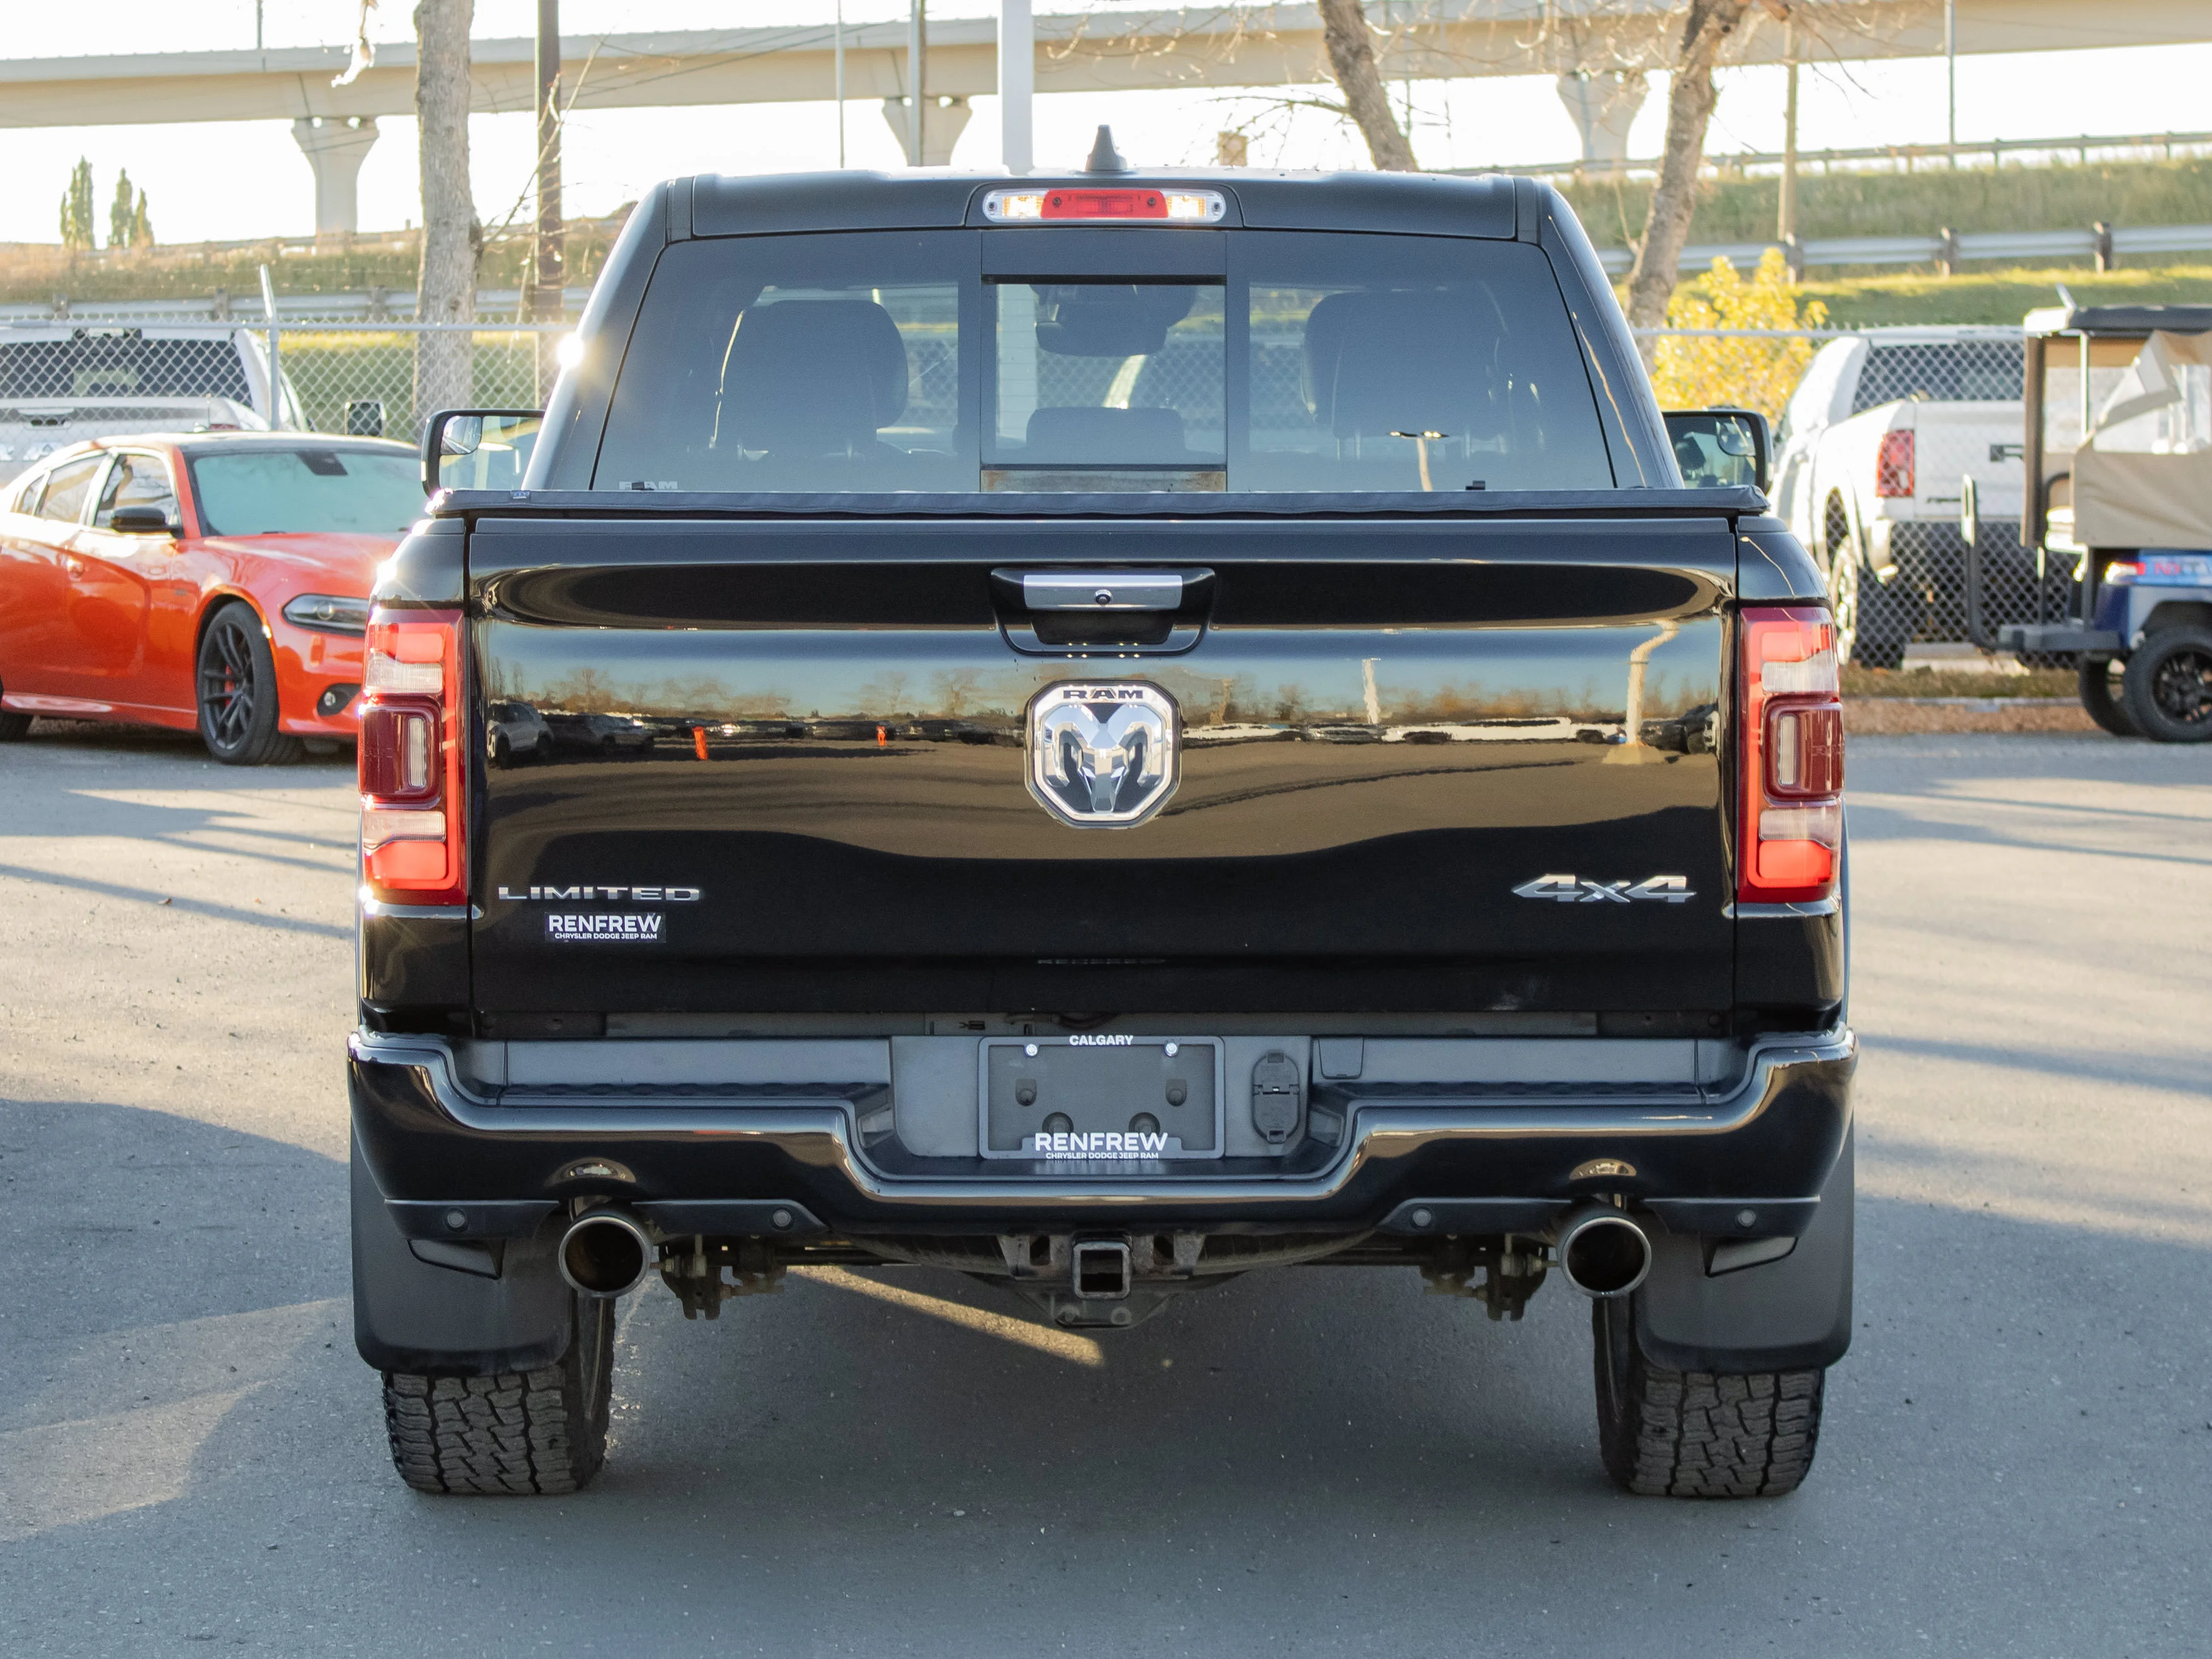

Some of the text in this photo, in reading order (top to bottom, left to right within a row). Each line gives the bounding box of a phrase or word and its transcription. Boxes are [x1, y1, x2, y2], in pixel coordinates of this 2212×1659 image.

[1063, 689, 1143, 699] RAM
[498, 887, 701, 901] LIMITED
[549, 915, 662, 933] RENFREW
[1069, 1035, 1134, 1046] CALGARY
[1034, 1132, 1168, 1151] RENFREW
